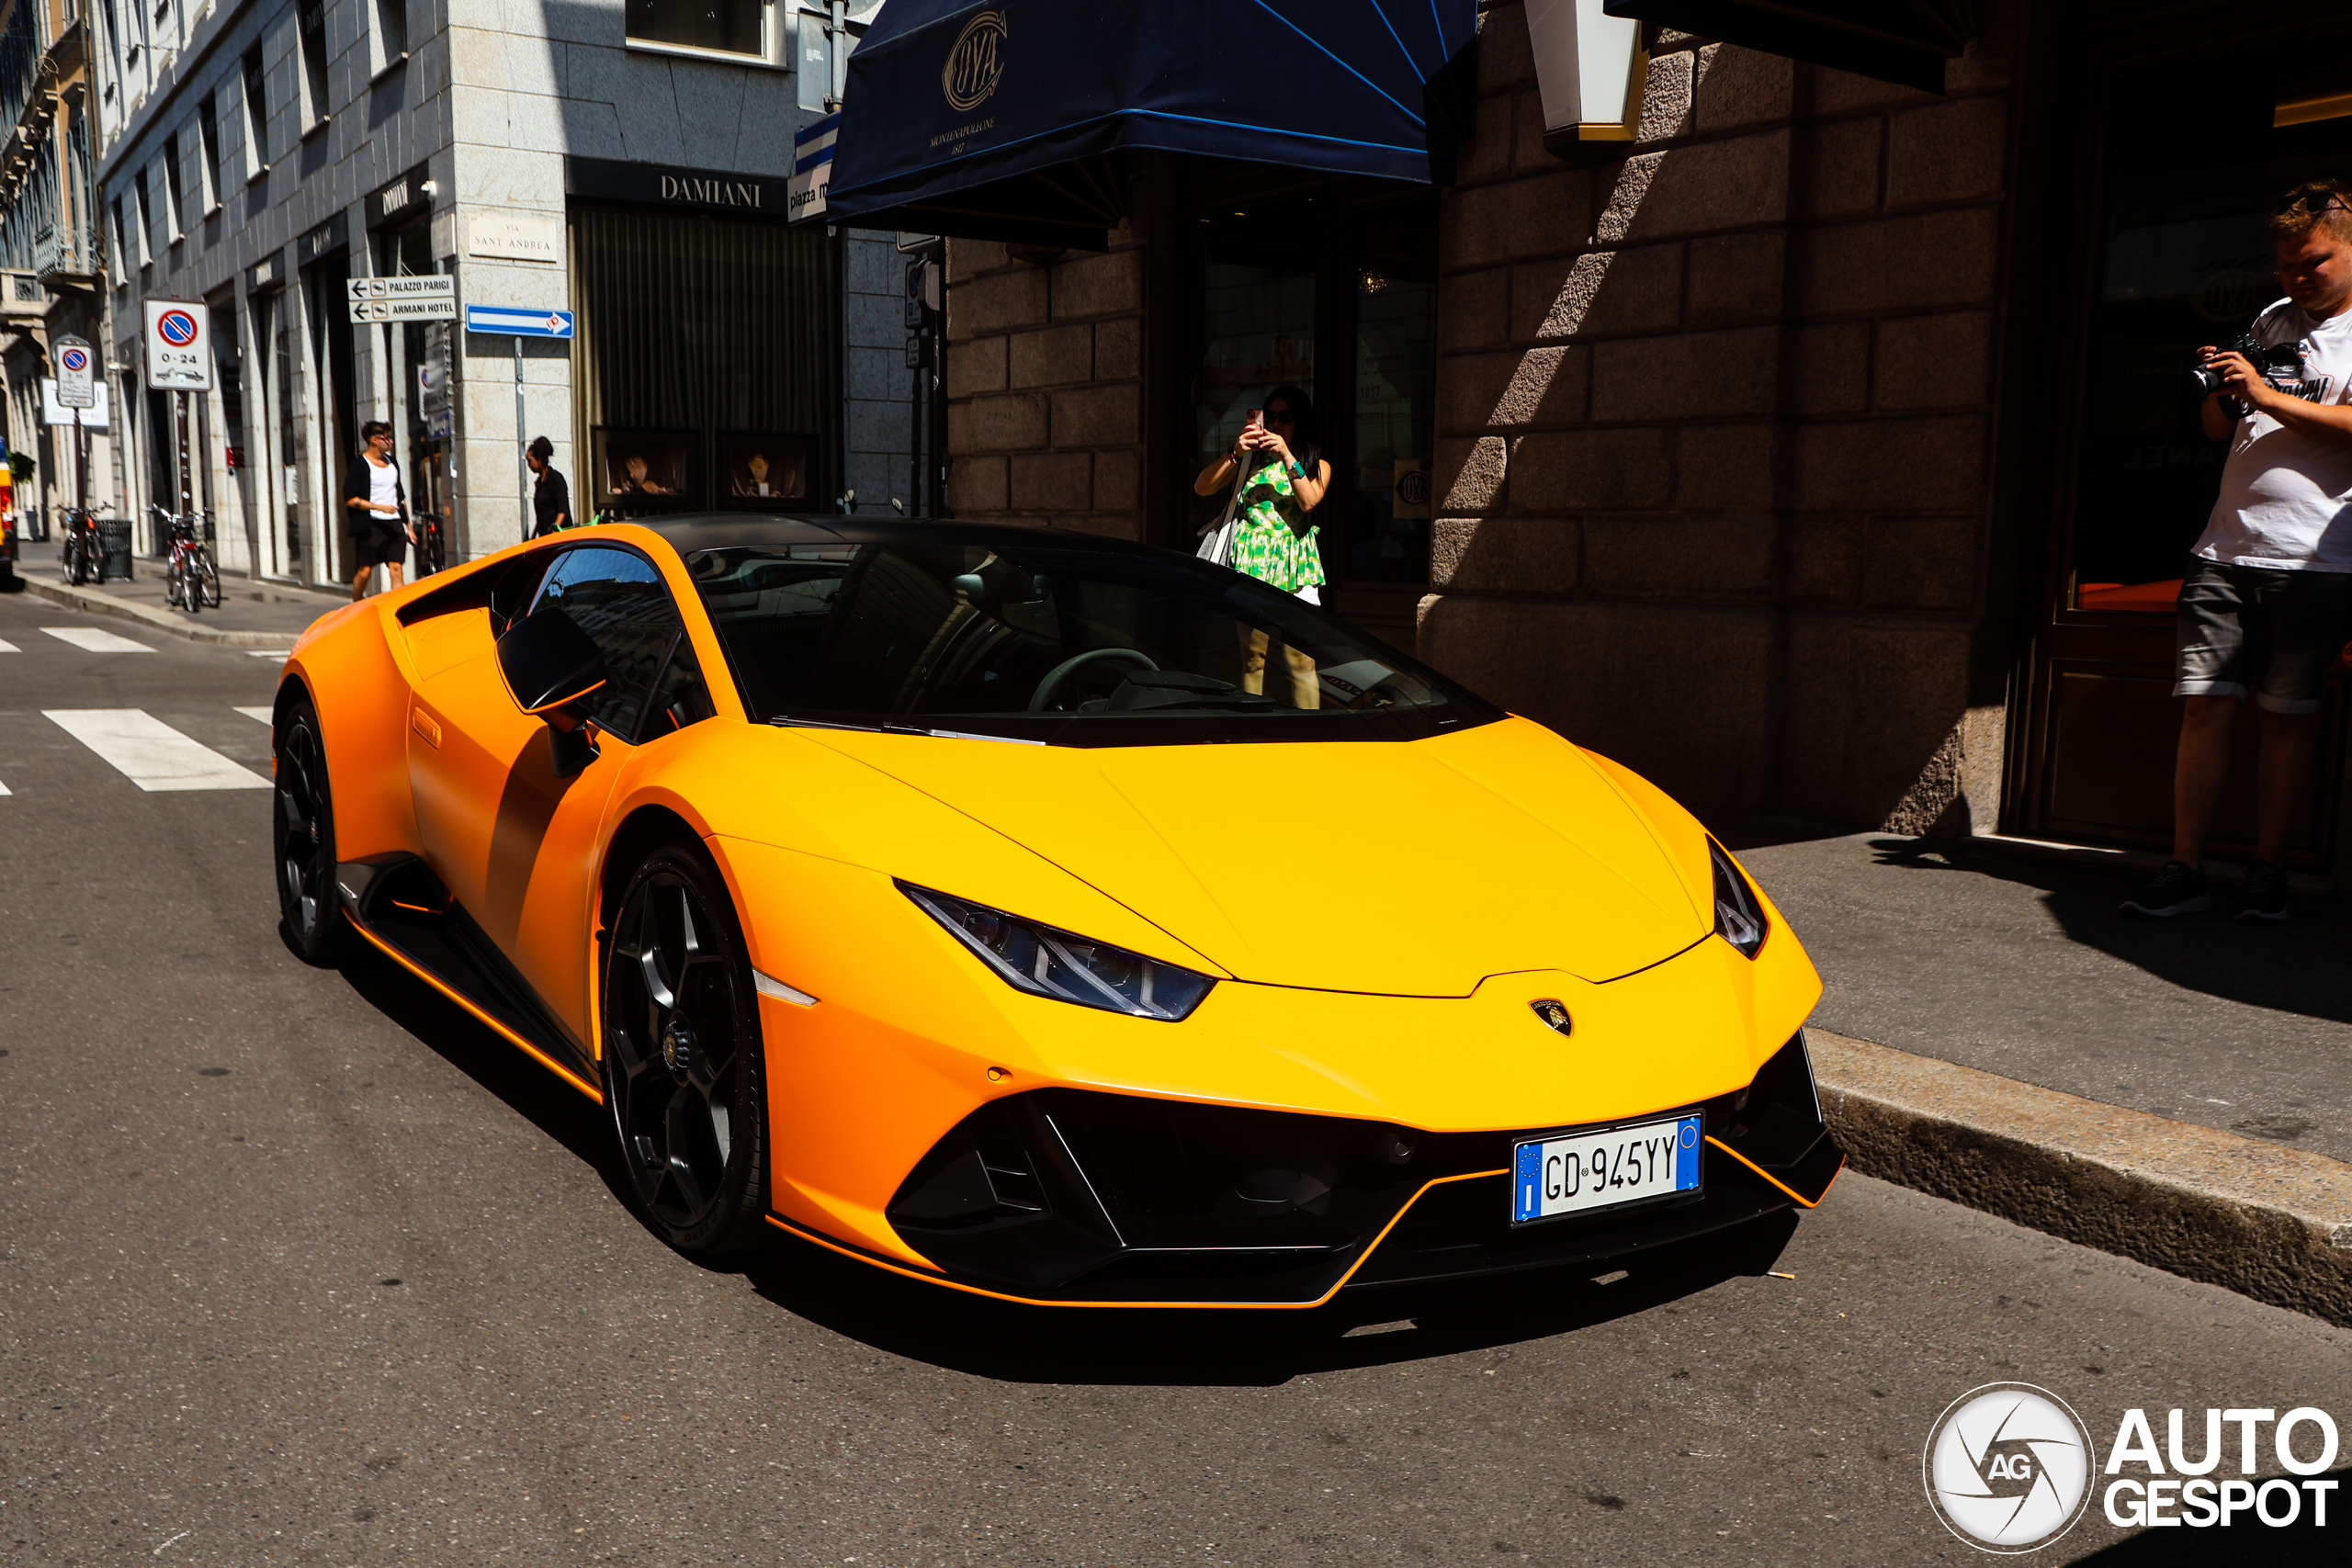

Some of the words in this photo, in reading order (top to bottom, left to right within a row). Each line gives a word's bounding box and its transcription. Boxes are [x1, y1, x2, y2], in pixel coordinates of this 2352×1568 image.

[930, 117, 995, 147] MONTENAPOLEONE
[661, 175, 761, 209] DAMIANI
[790, 189, 816, 212] piazza
[505, 224, 519, 232] VIA
[509, 239, 550, 251] ANDREA
[389, 282, 422, 292] PALAZZO
[424, 280, 449, 290] PARIGI
[392, 304, 426, 314] ARMANI
[427, 303, 454, 313] HOTEL
[180, 354, 197, 365] 24
[1359, 385, 1381, 398] 1817
